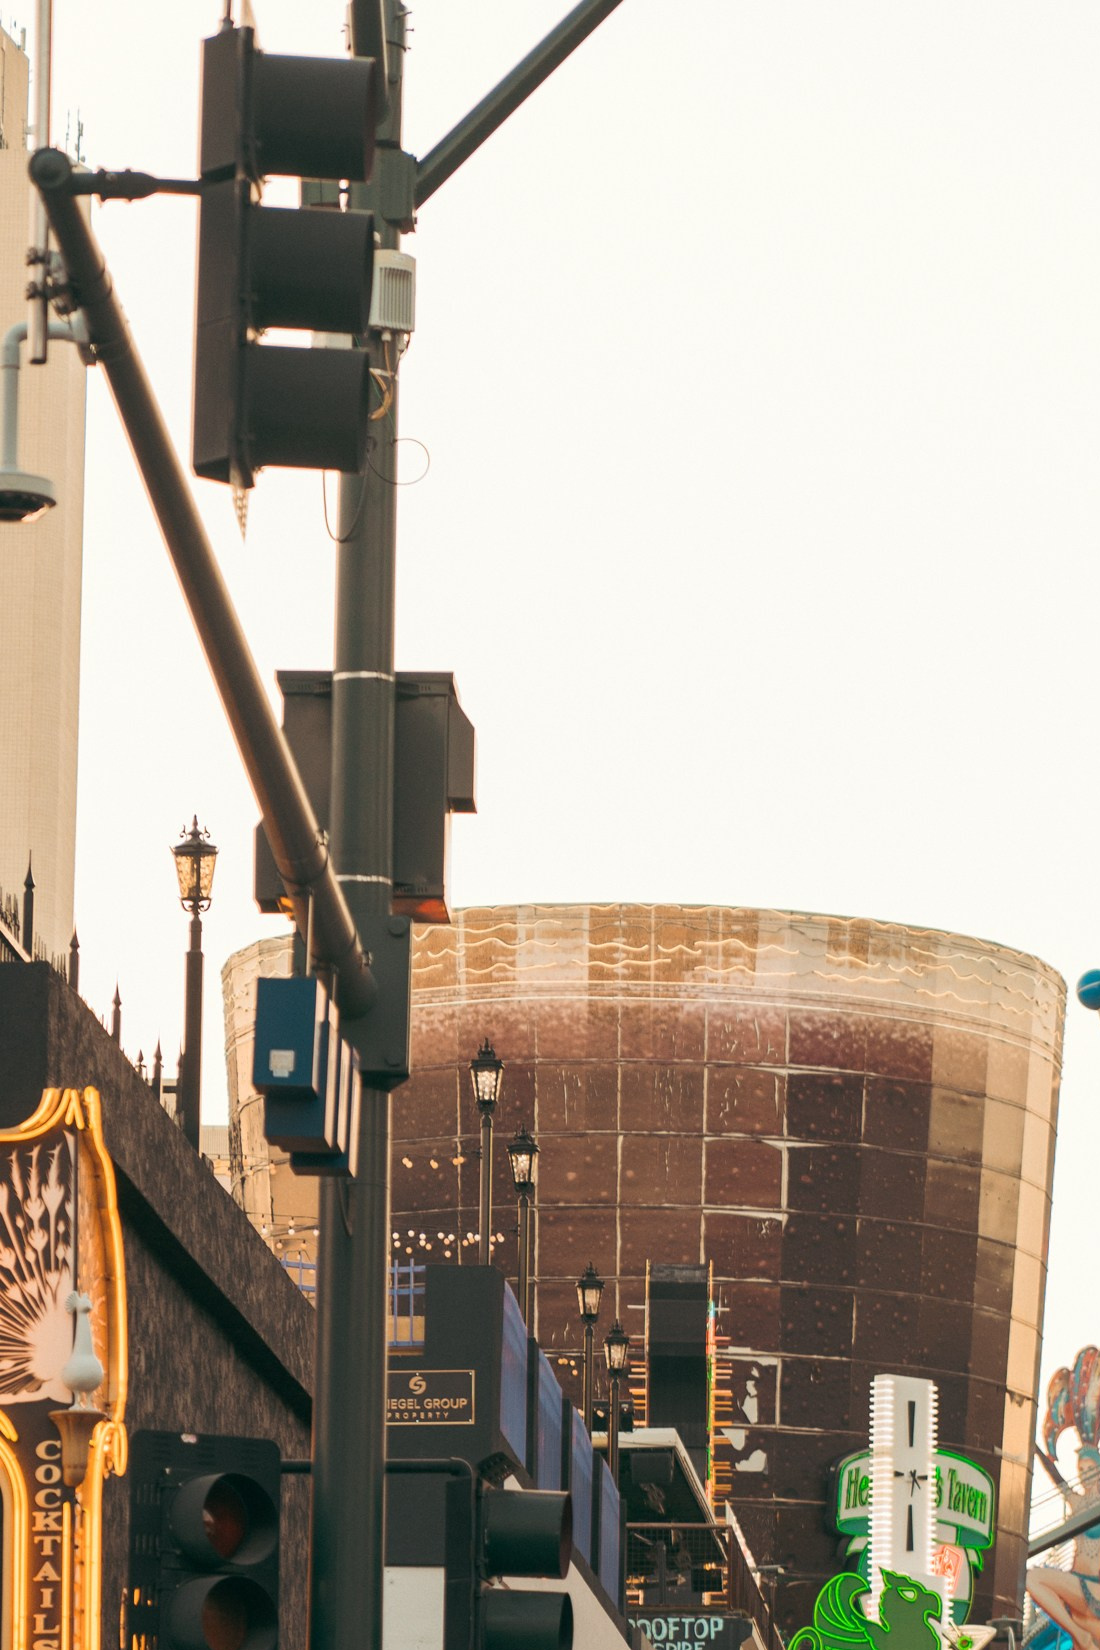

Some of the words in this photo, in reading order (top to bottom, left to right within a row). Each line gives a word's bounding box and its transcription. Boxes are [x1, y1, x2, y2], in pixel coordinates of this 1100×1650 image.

[387, 1398, 421, 1410] IEGEL
[423, 1397, 468, 1410] GROUP
[948, 1468, 988, 1525] Tavern
[628, 1616, 724, 1641] OOFTOP
